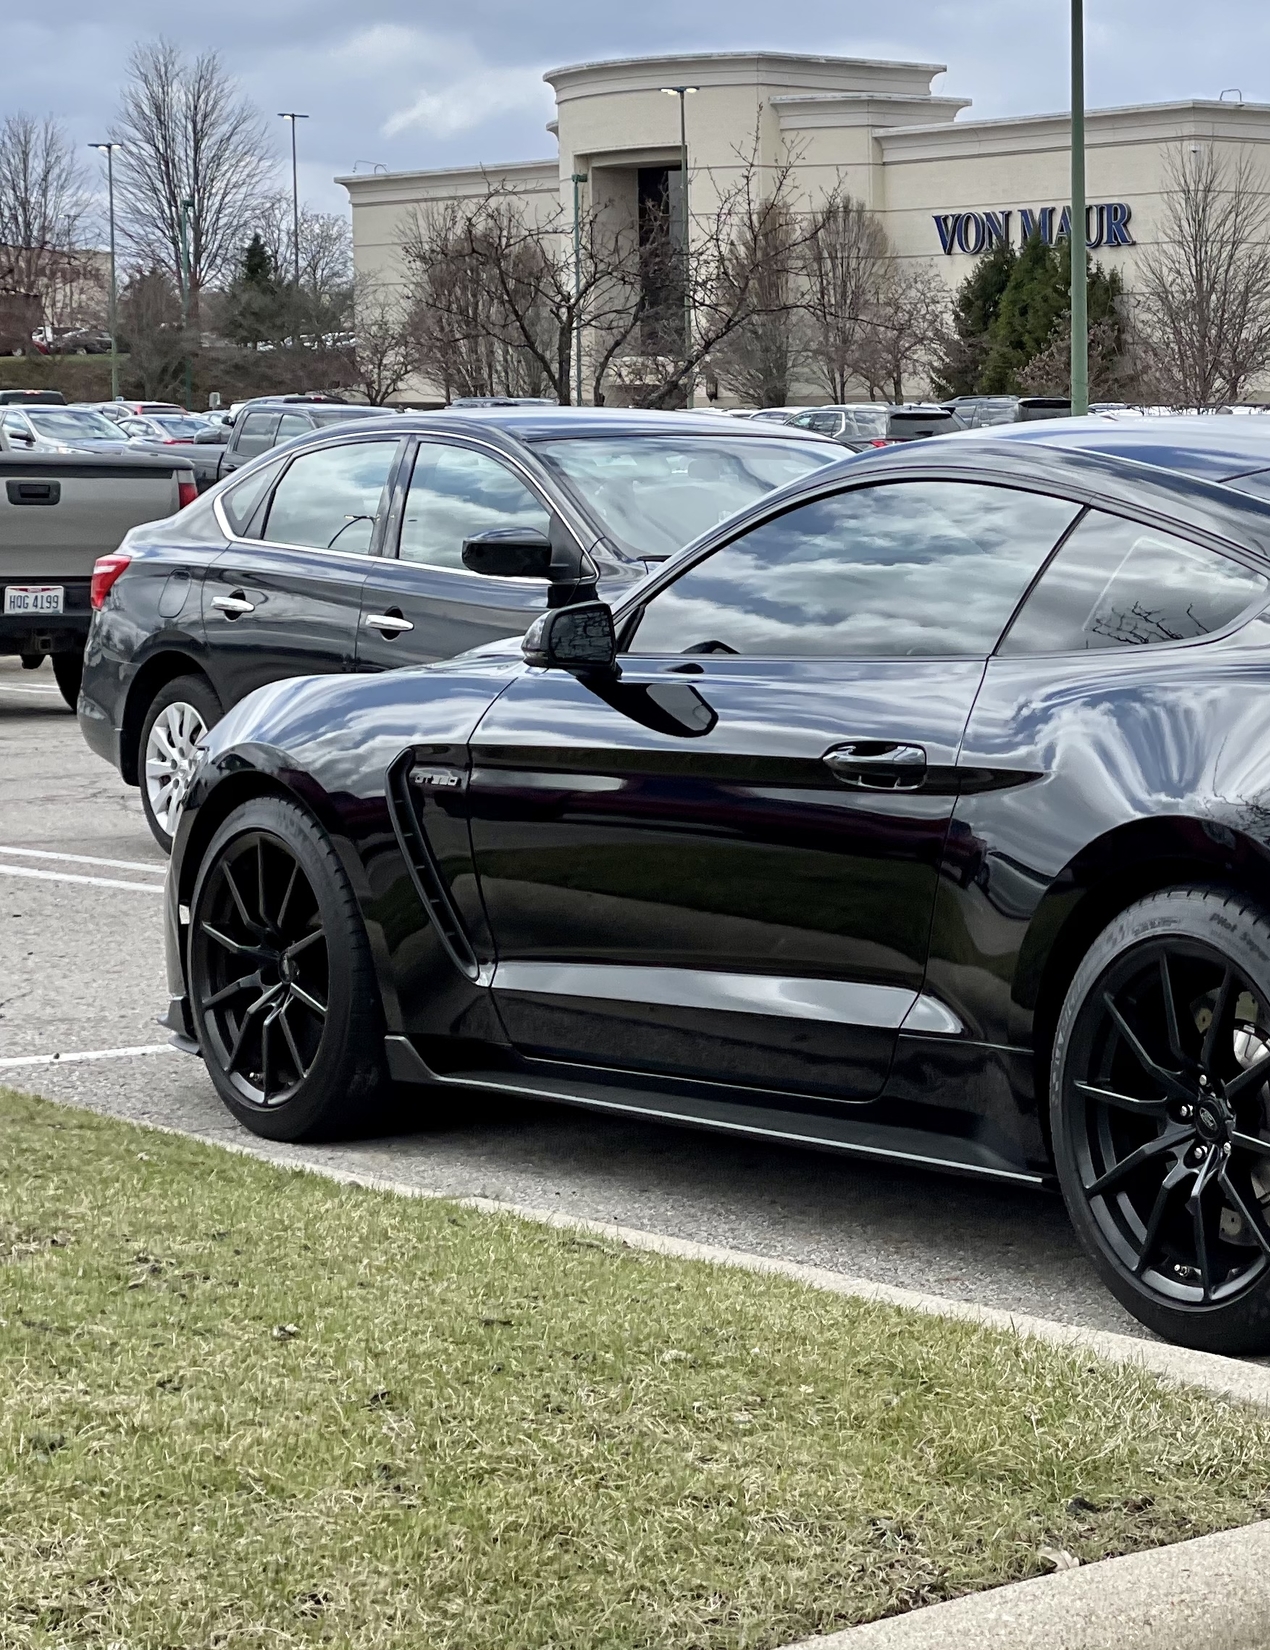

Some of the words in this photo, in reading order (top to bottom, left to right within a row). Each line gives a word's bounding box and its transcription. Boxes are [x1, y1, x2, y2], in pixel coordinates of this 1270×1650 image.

[932, 210, 1012, 255] VON
[1018, 203, 1136, 249] MAUR
[32, 595, 59, 610] 4199
